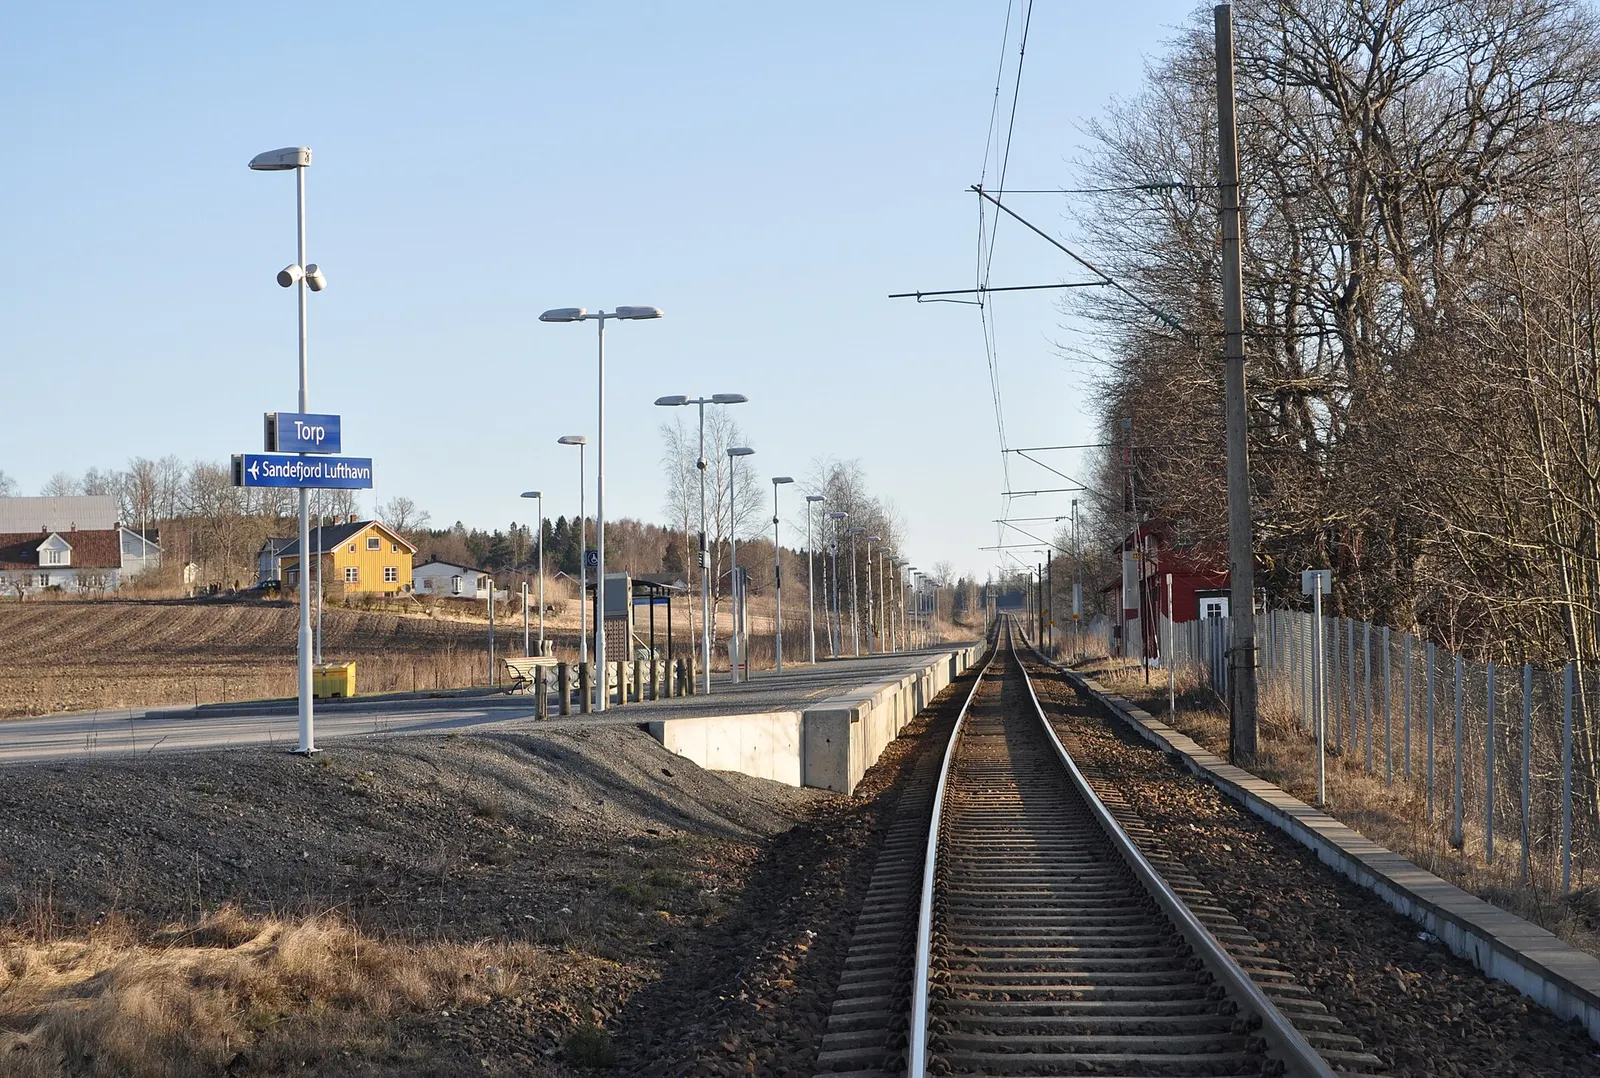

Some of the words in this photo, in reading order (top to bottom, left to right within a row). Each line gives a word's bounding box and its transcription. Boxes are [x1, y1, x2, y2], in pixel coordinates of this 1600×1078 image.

[294, 421, 325, 445] Torp
[262, 461, 321, 482] Sandefjord
[324, 463, 370, 479] Lufthavn
